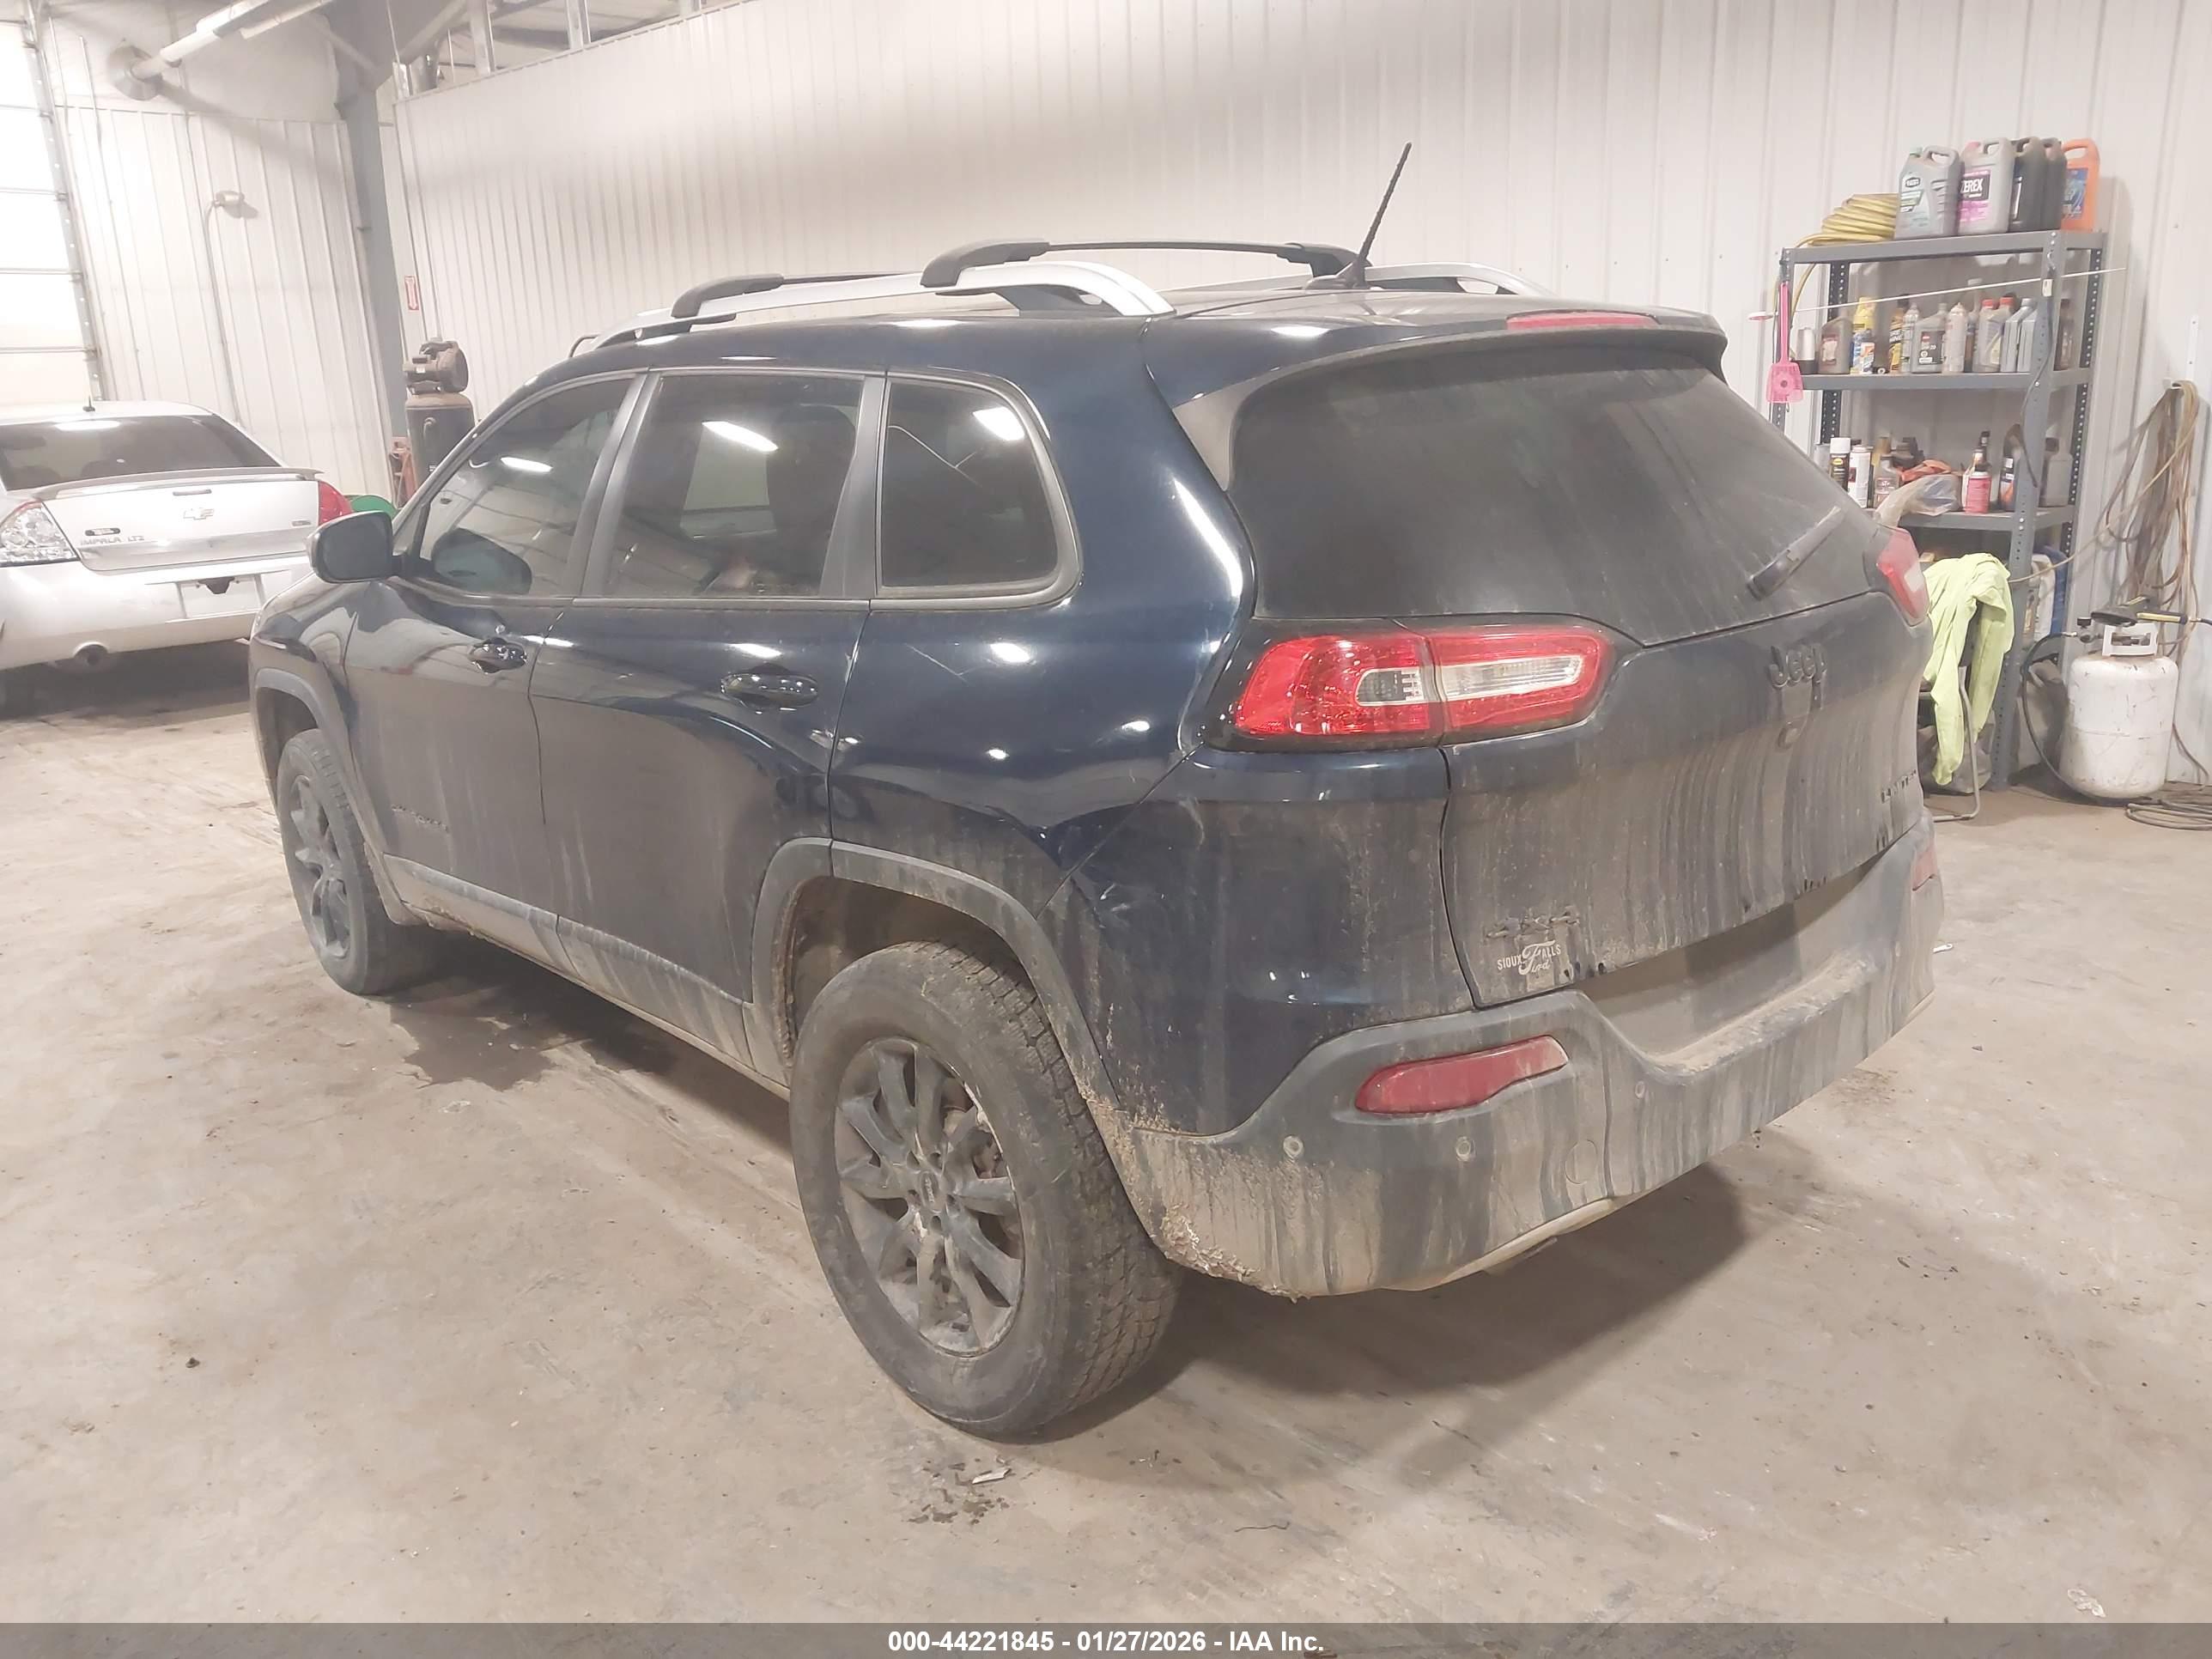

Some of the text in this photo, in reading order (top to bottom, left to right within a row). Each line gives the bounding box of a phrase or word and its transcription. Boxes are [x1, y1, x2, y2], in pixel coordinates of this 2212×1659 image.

[80, 537, 122, 545] IMPALA
[1768, 644, 1828, 688] Jeep
[1497, 954, 1522, 971] SIOUX
